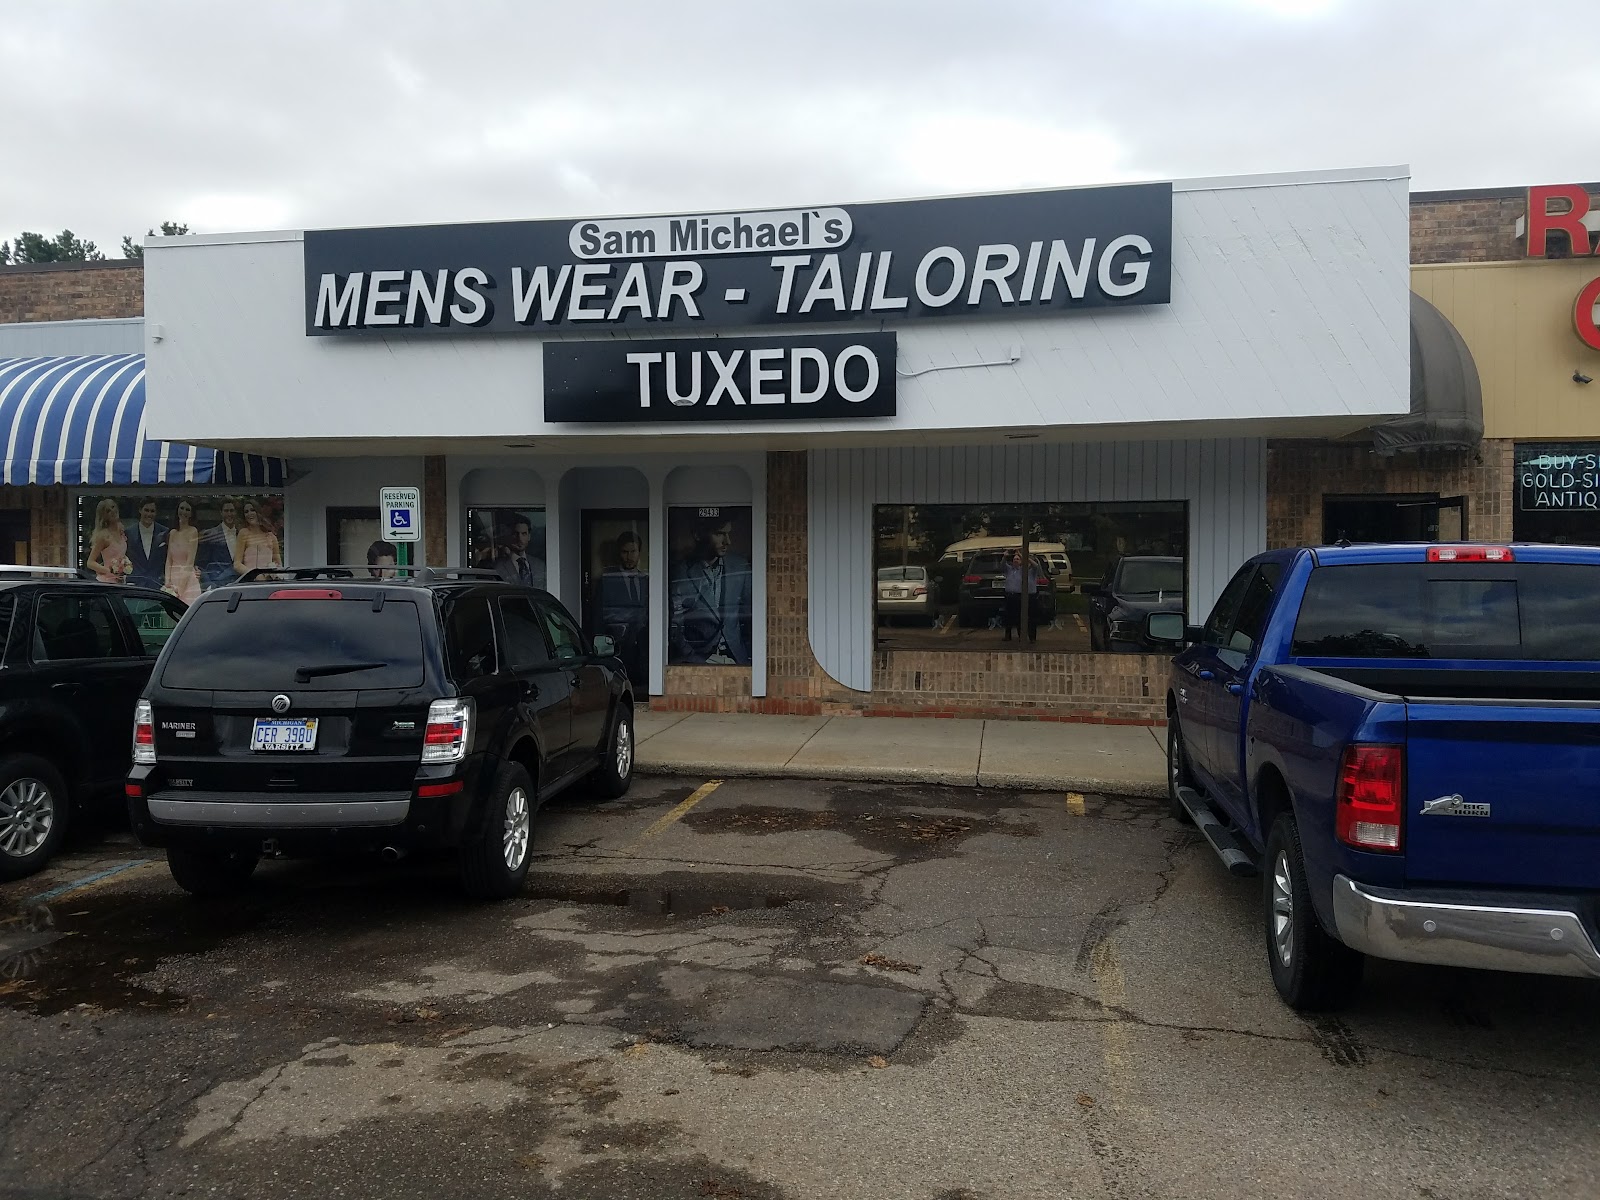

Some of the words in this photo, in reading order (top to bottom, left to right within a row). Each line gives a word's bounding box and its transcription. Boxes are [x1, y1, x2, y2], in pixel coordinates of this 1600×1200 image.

[1527, 184, 1600, 257] R
[579, 223, 656, 256] Sam
[314, 266, 489, 327] MENS
[511, 260, 704, 322] WEAR
[724, 288, 746, 301] -
[770, 234, 1154, 314] TAILORING
[626, 344, 880, 408] TUXEDO
[1538, 453, 1600, 470] BUY-S
[384, 492, 416, 500] RESERVED
[1535, 491, 1598, 509] ANTIQ
[385, 501, 415, 509] PARKING
[699, 508, 719, 517] 29433
[161, 721, 196, 730] MARINER
[256, 727, 278, 743] CER
[264, 743, 301, 751] VARSITY
